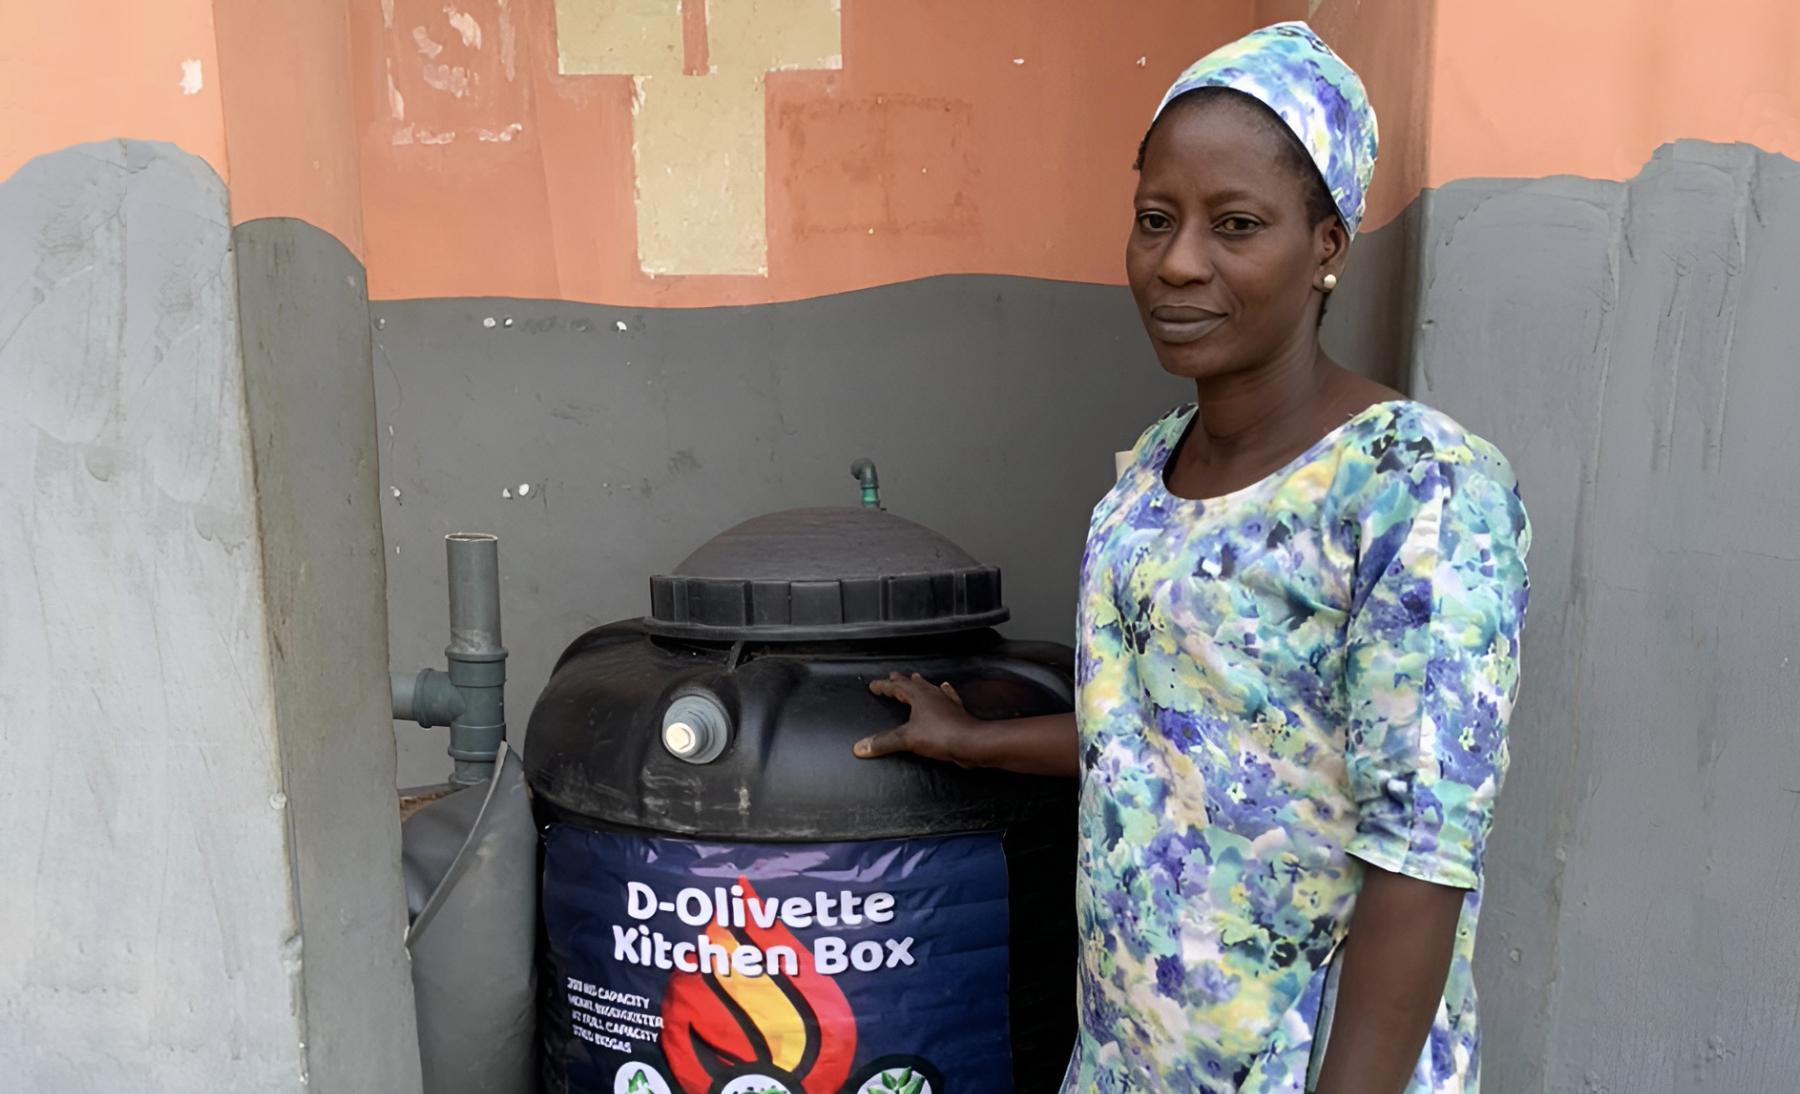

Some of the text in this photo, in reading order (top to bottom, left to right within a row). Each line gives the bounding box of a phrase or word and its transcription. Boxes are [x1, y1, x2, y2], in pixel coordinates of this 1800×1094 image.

[626, 880, 895, 929] D-Olivette
[612, 924, 916, 977] Kitchen Box
[605, 1021, 658, 1043] CAPACITY
